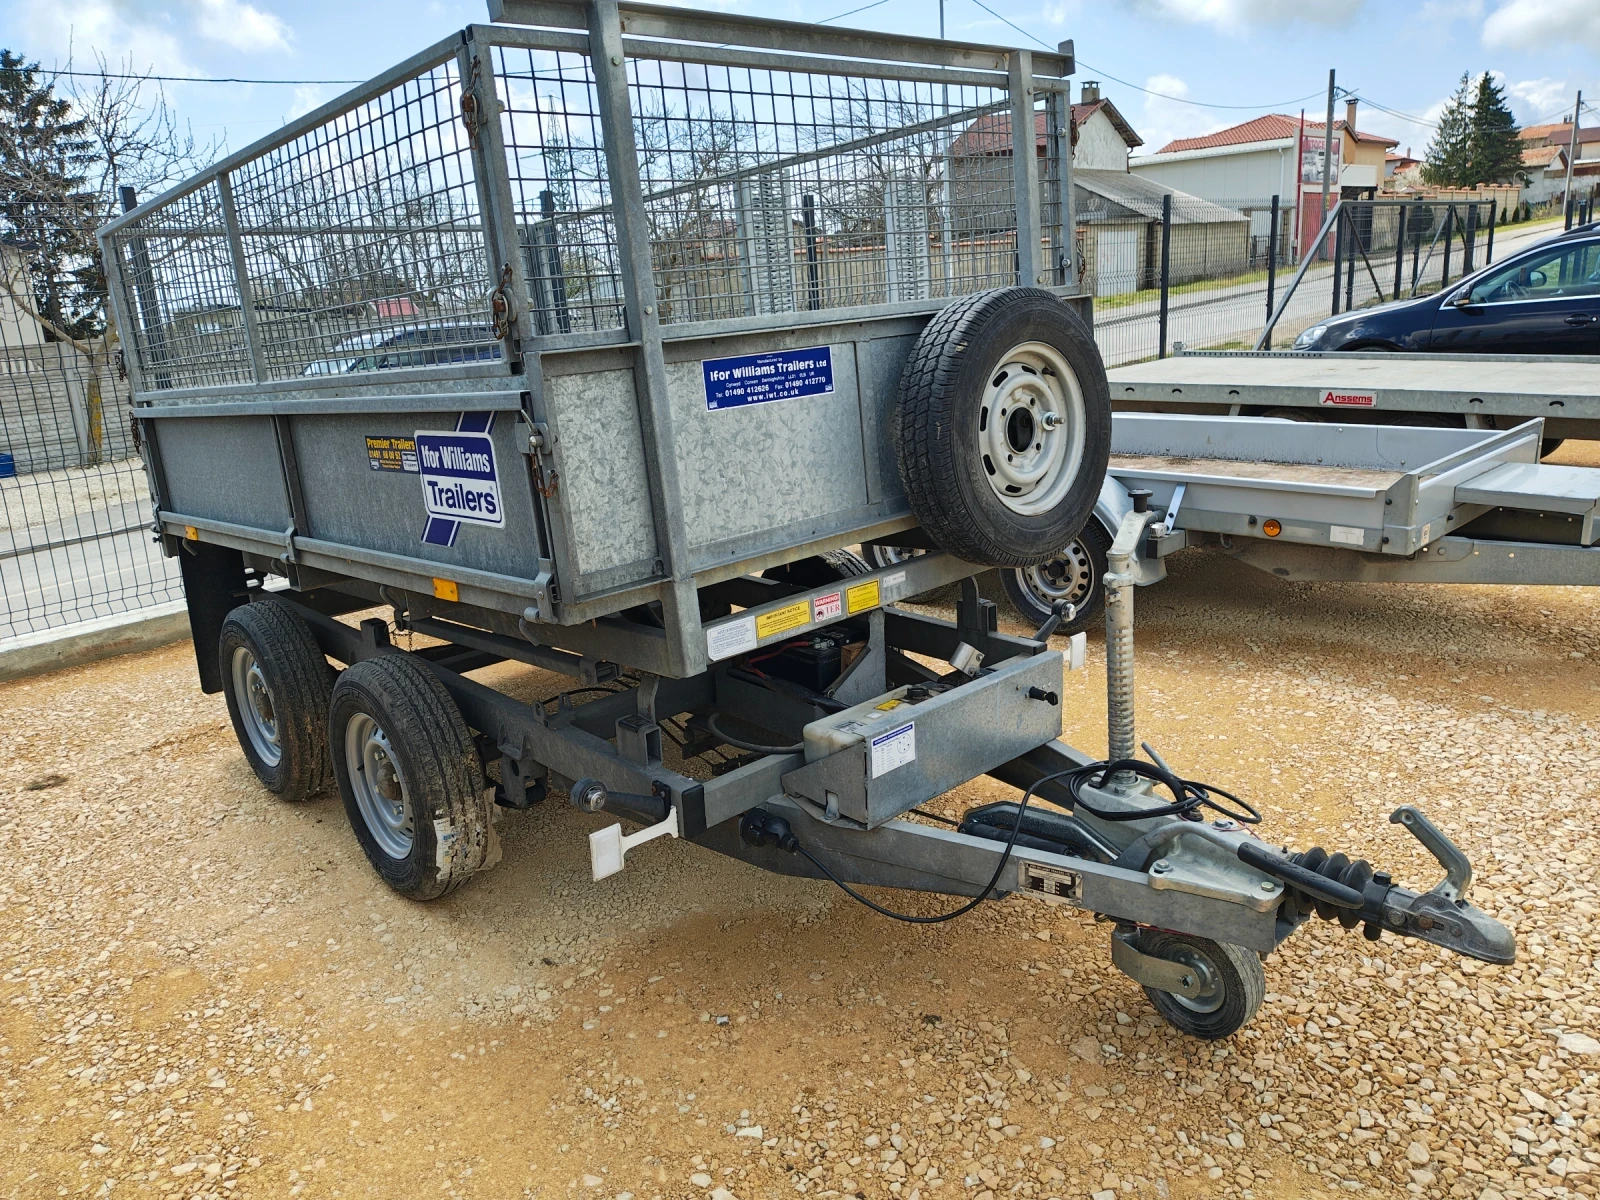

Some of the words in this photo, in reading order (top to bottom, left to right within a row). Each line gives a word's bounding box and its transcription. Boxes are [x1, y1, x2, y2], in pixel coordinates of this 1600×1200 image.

[710, 370, 730, 382] Ifor
[732, 365, 775, 379] Williams
[777, 360, 814, 372] Trailers
[816, 360, 826, 368] Ltd
[725, 389, 745, 397] 01490
[746, 385, 770, 394] 412626
[785, 380, 803, 388] 01490
[805, 377, 826, 386] 412770
[747, 388, 799, 402] www.iwt.co.uk
[1323, 392, 1372, 405] Anssems
[366, 437, 390, 449] Premier
[391, 438, 415, 450] Trailers
[421, 445, 440, 469] Ifor
[440, 446, 490, 473] Williams
[427, 480, 497, 514] Trailers
[815, 594, 839, 606] WARNING!
[766, 609, 786, 620] IMPORTANT
